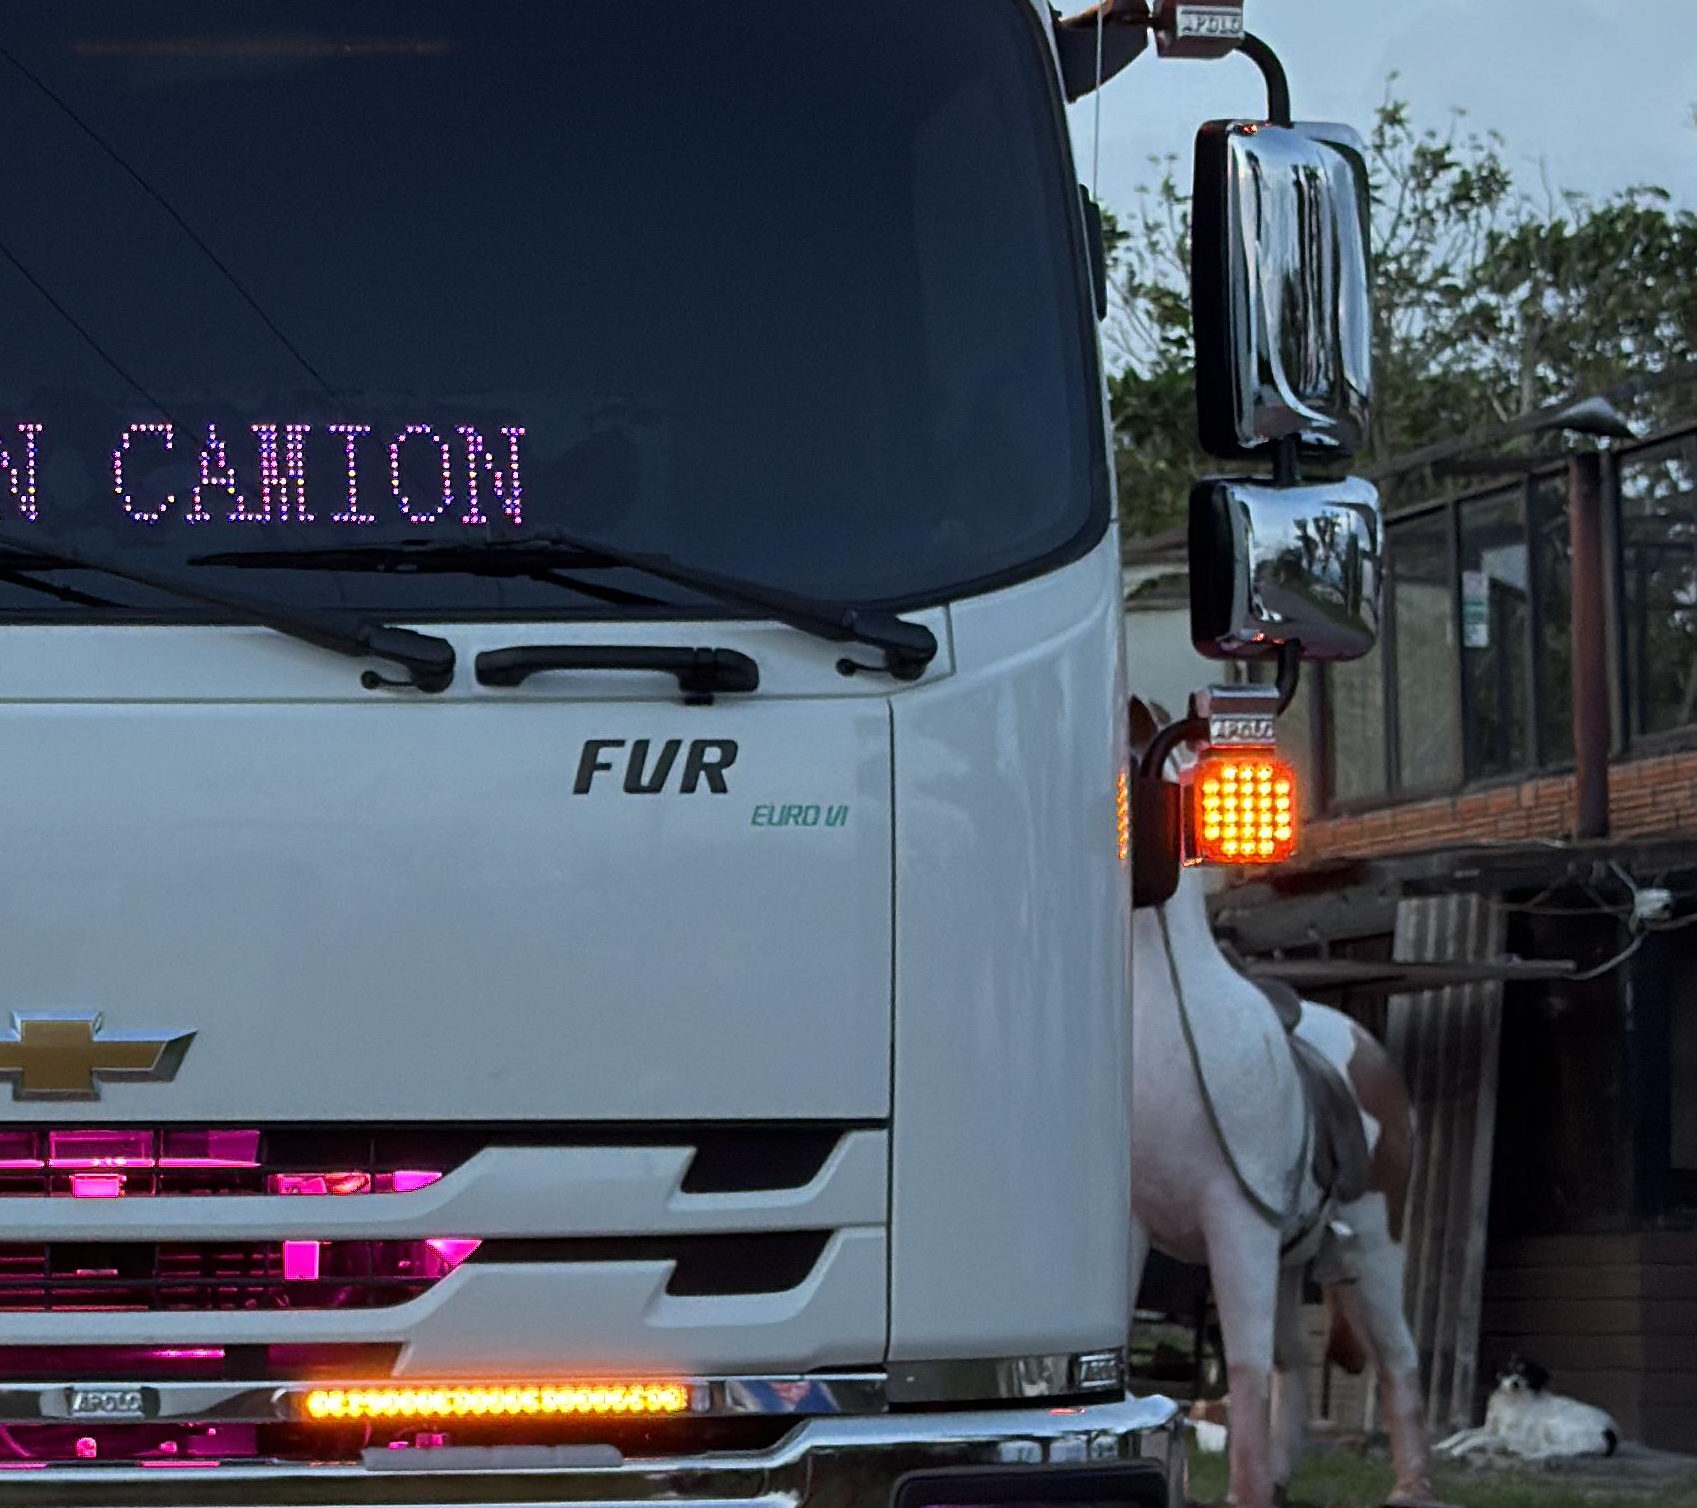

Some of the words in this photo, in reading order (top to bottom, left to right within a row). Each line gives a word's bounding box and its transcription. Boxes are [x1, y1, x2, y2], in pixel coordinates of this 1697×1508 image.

[572, 739, 739, 795] FUR
[751, 805, 821, 827] EURO
[824, 805, 849, 827] VI
[72, 1390, 143, 1413] APOLO
